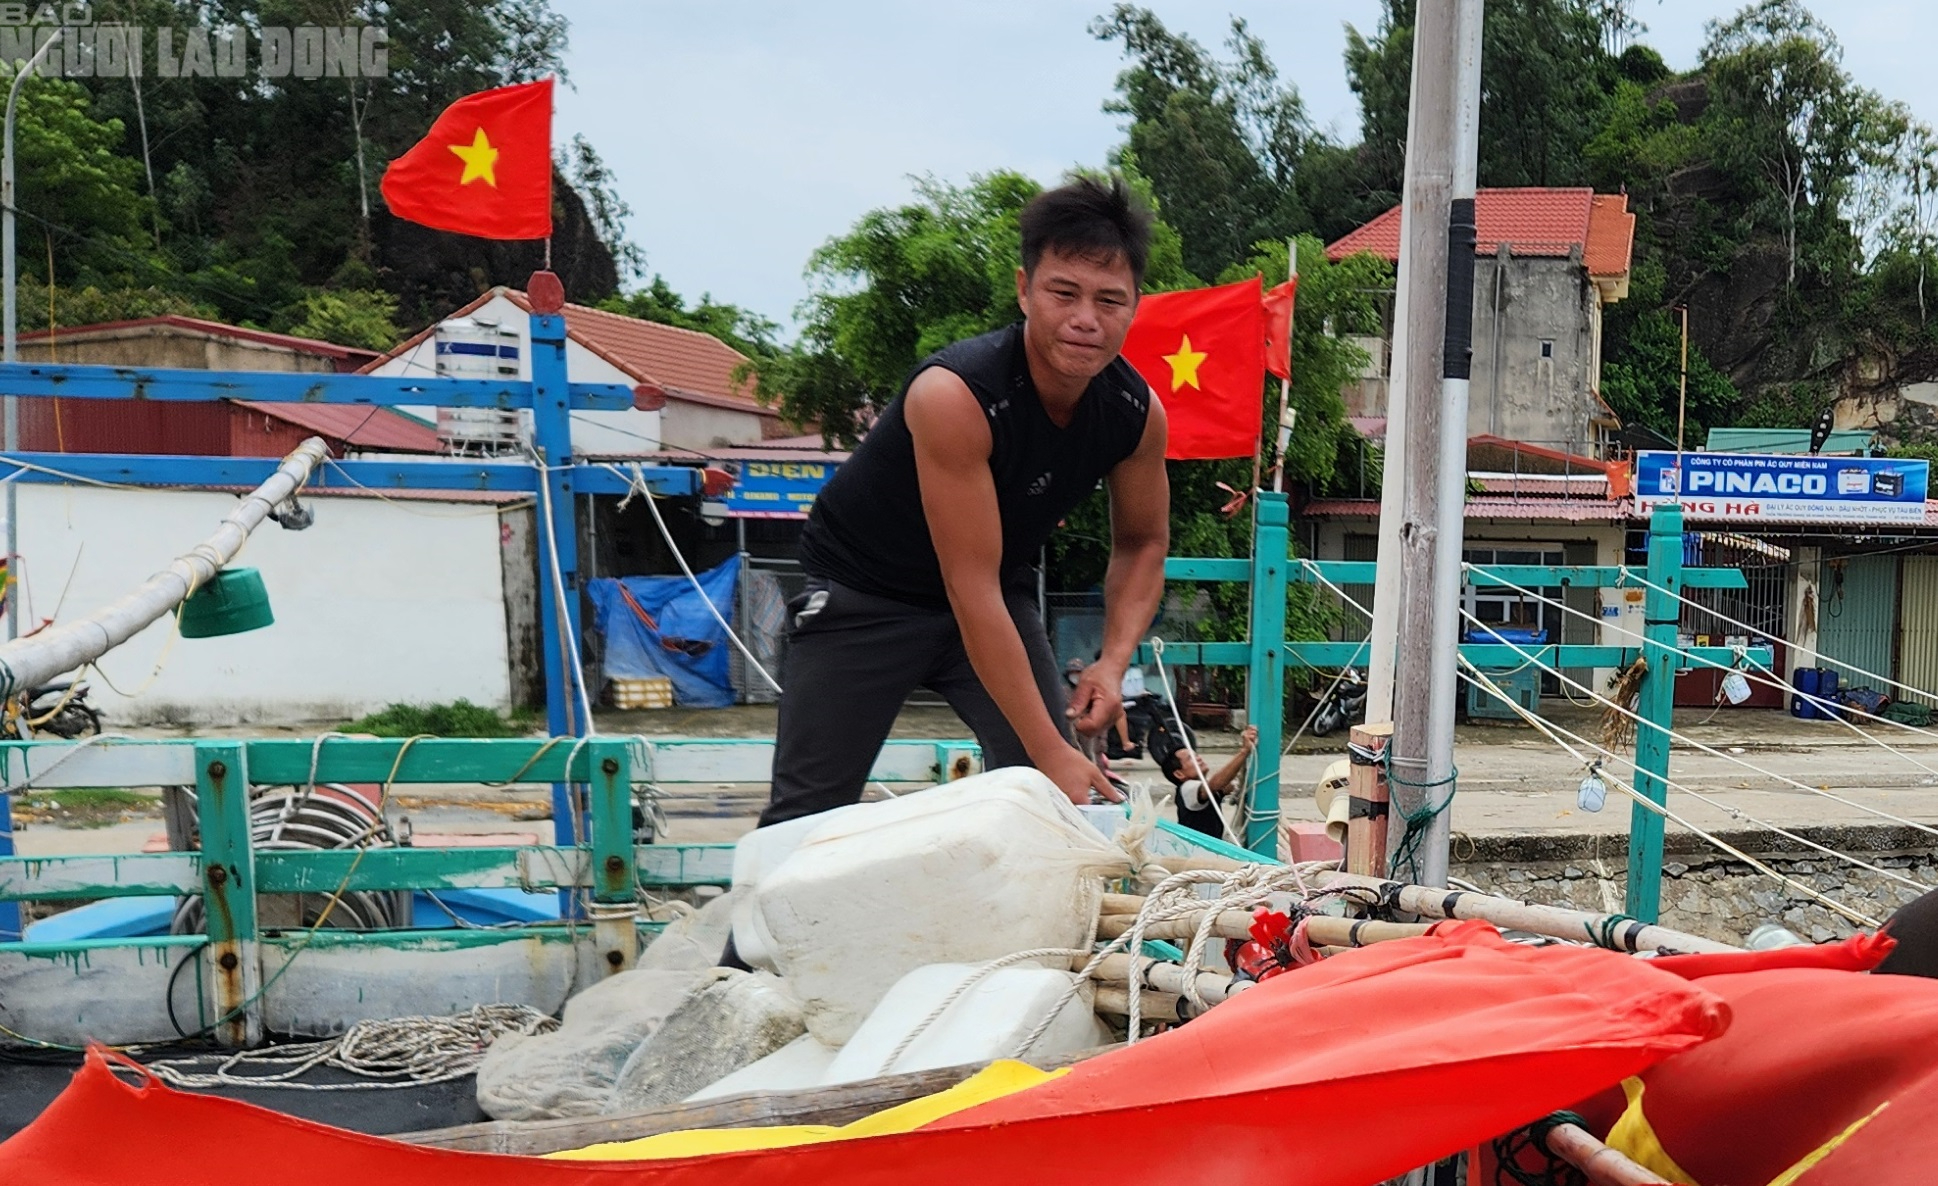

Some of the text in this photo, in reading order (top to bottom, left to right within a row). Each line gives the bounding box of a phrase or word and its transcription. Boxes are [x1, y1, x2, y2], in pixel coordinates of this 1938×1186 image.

[1812, 461, 1828, 470] NAM
[1689, 471, 1827, 495] PINACO
[1726, 500, 1760, 515] HÀ
